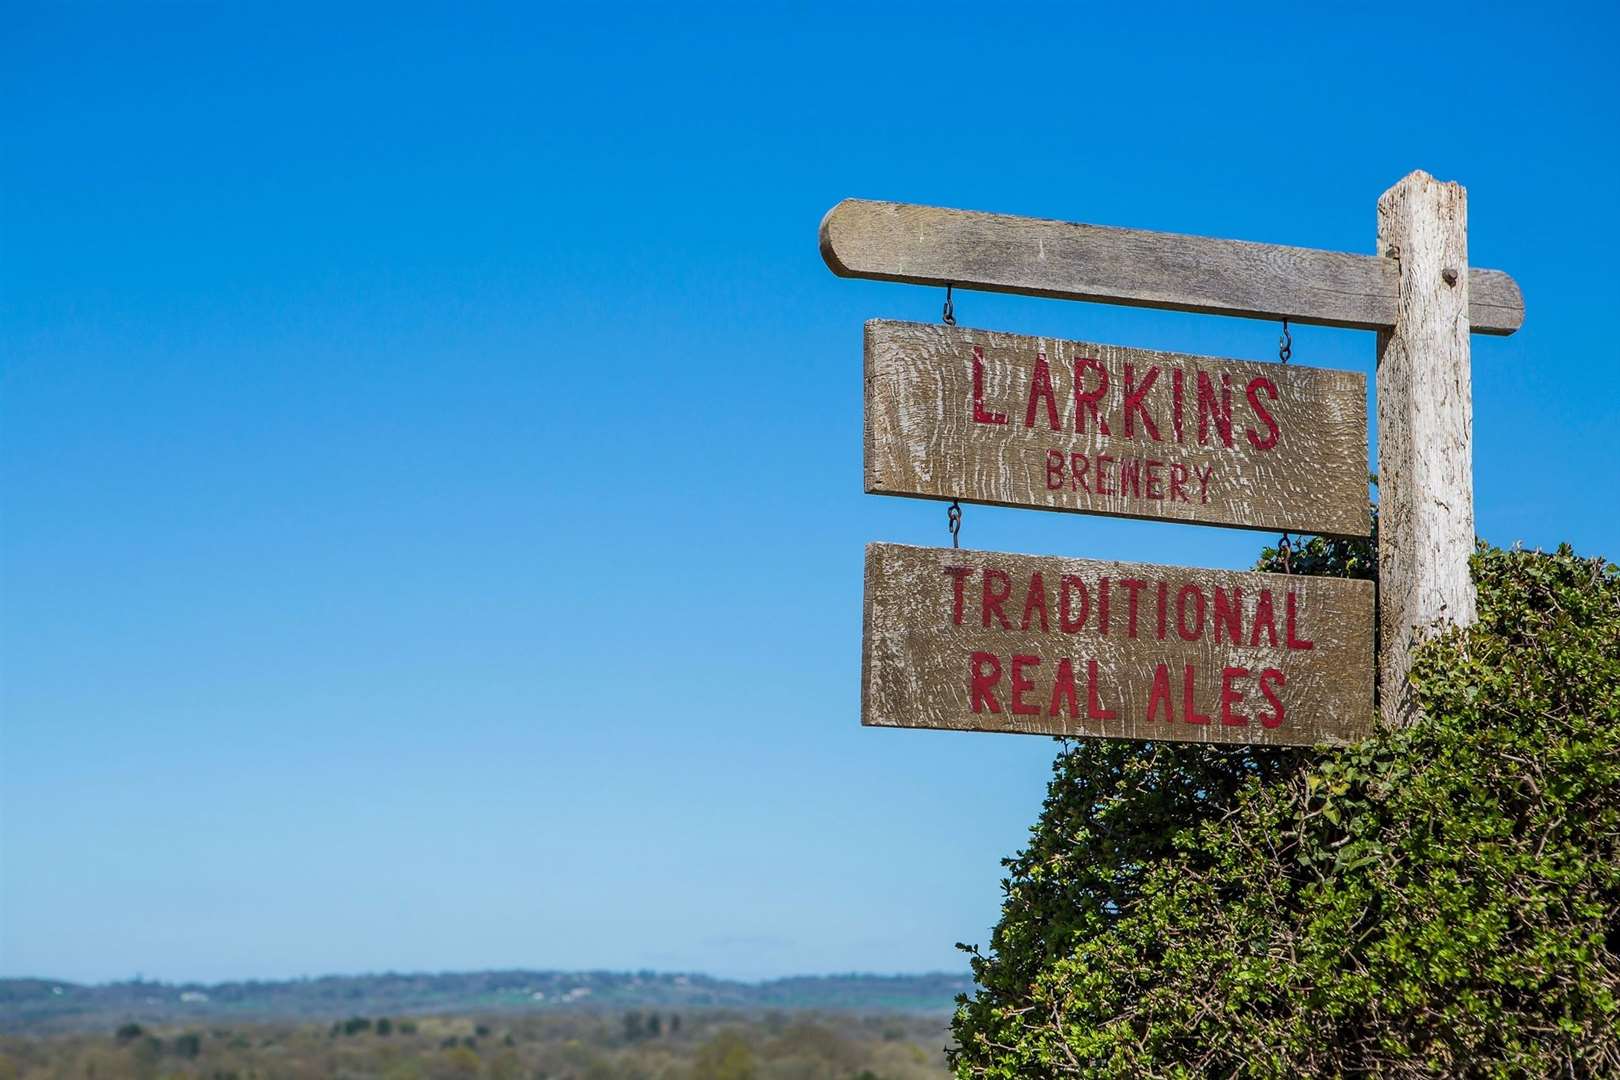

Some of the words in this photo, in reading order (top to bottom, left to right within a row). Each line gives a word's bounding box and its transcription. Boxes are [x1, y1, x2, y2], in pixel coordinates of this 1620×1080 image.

[972, 347, 1282, 451] LARKINS
[1045, 451, 1213, 504] BREWERY
[945, 565, 1315, 652] TRADITIONAL
[970, 652, 1119, 722] REAL
[1146, 663, 1288, 731] ALES
